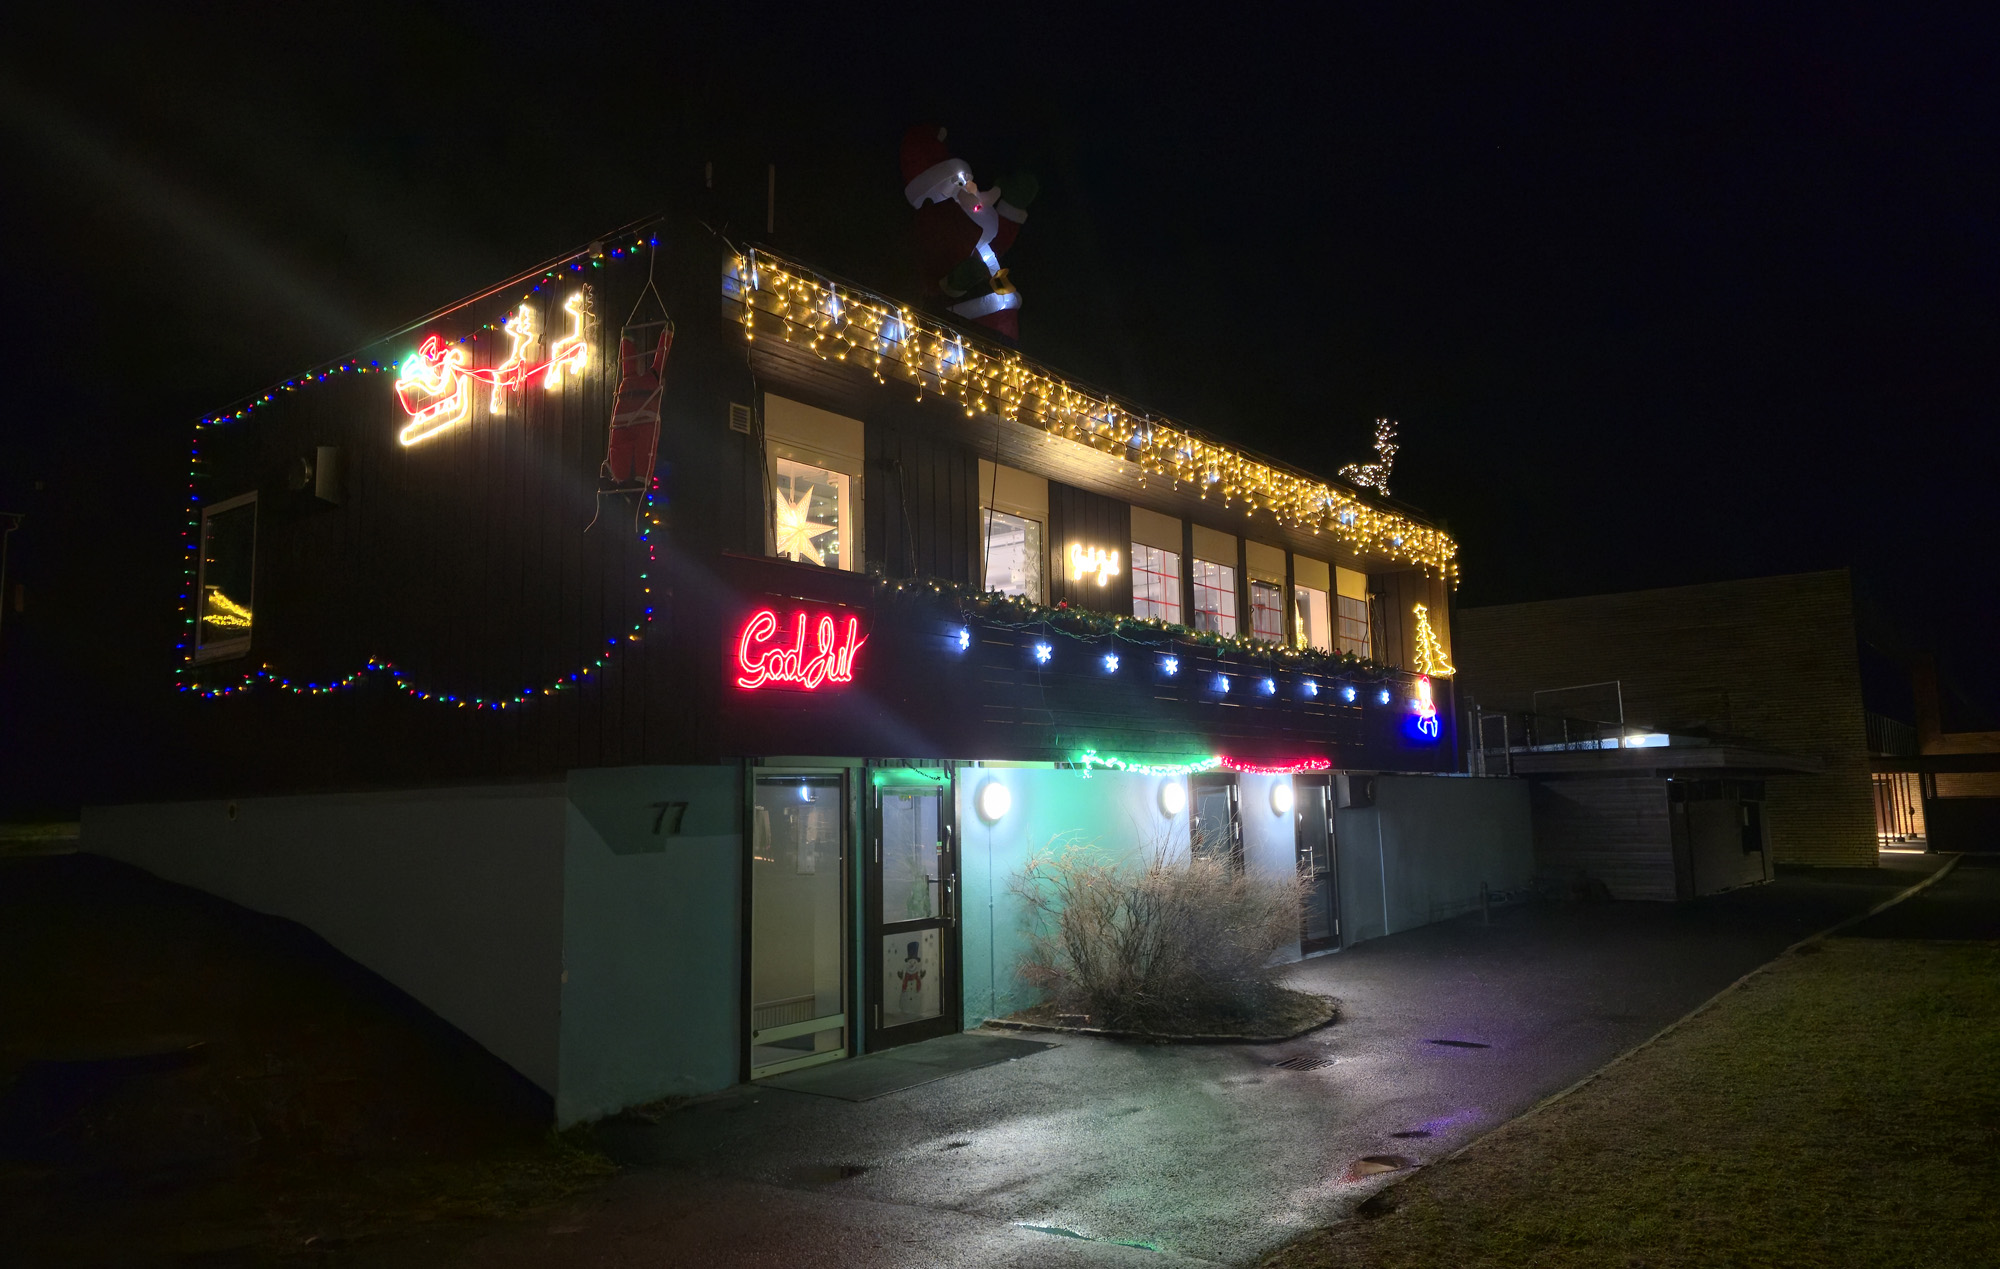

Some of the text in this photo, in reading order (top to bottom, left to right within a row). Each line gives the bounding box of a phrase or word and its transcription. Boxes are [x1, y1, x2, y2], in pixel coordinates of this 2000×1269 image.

[736, 610, 870, 689] God Jul
[650, 801, 689, 834] 77
